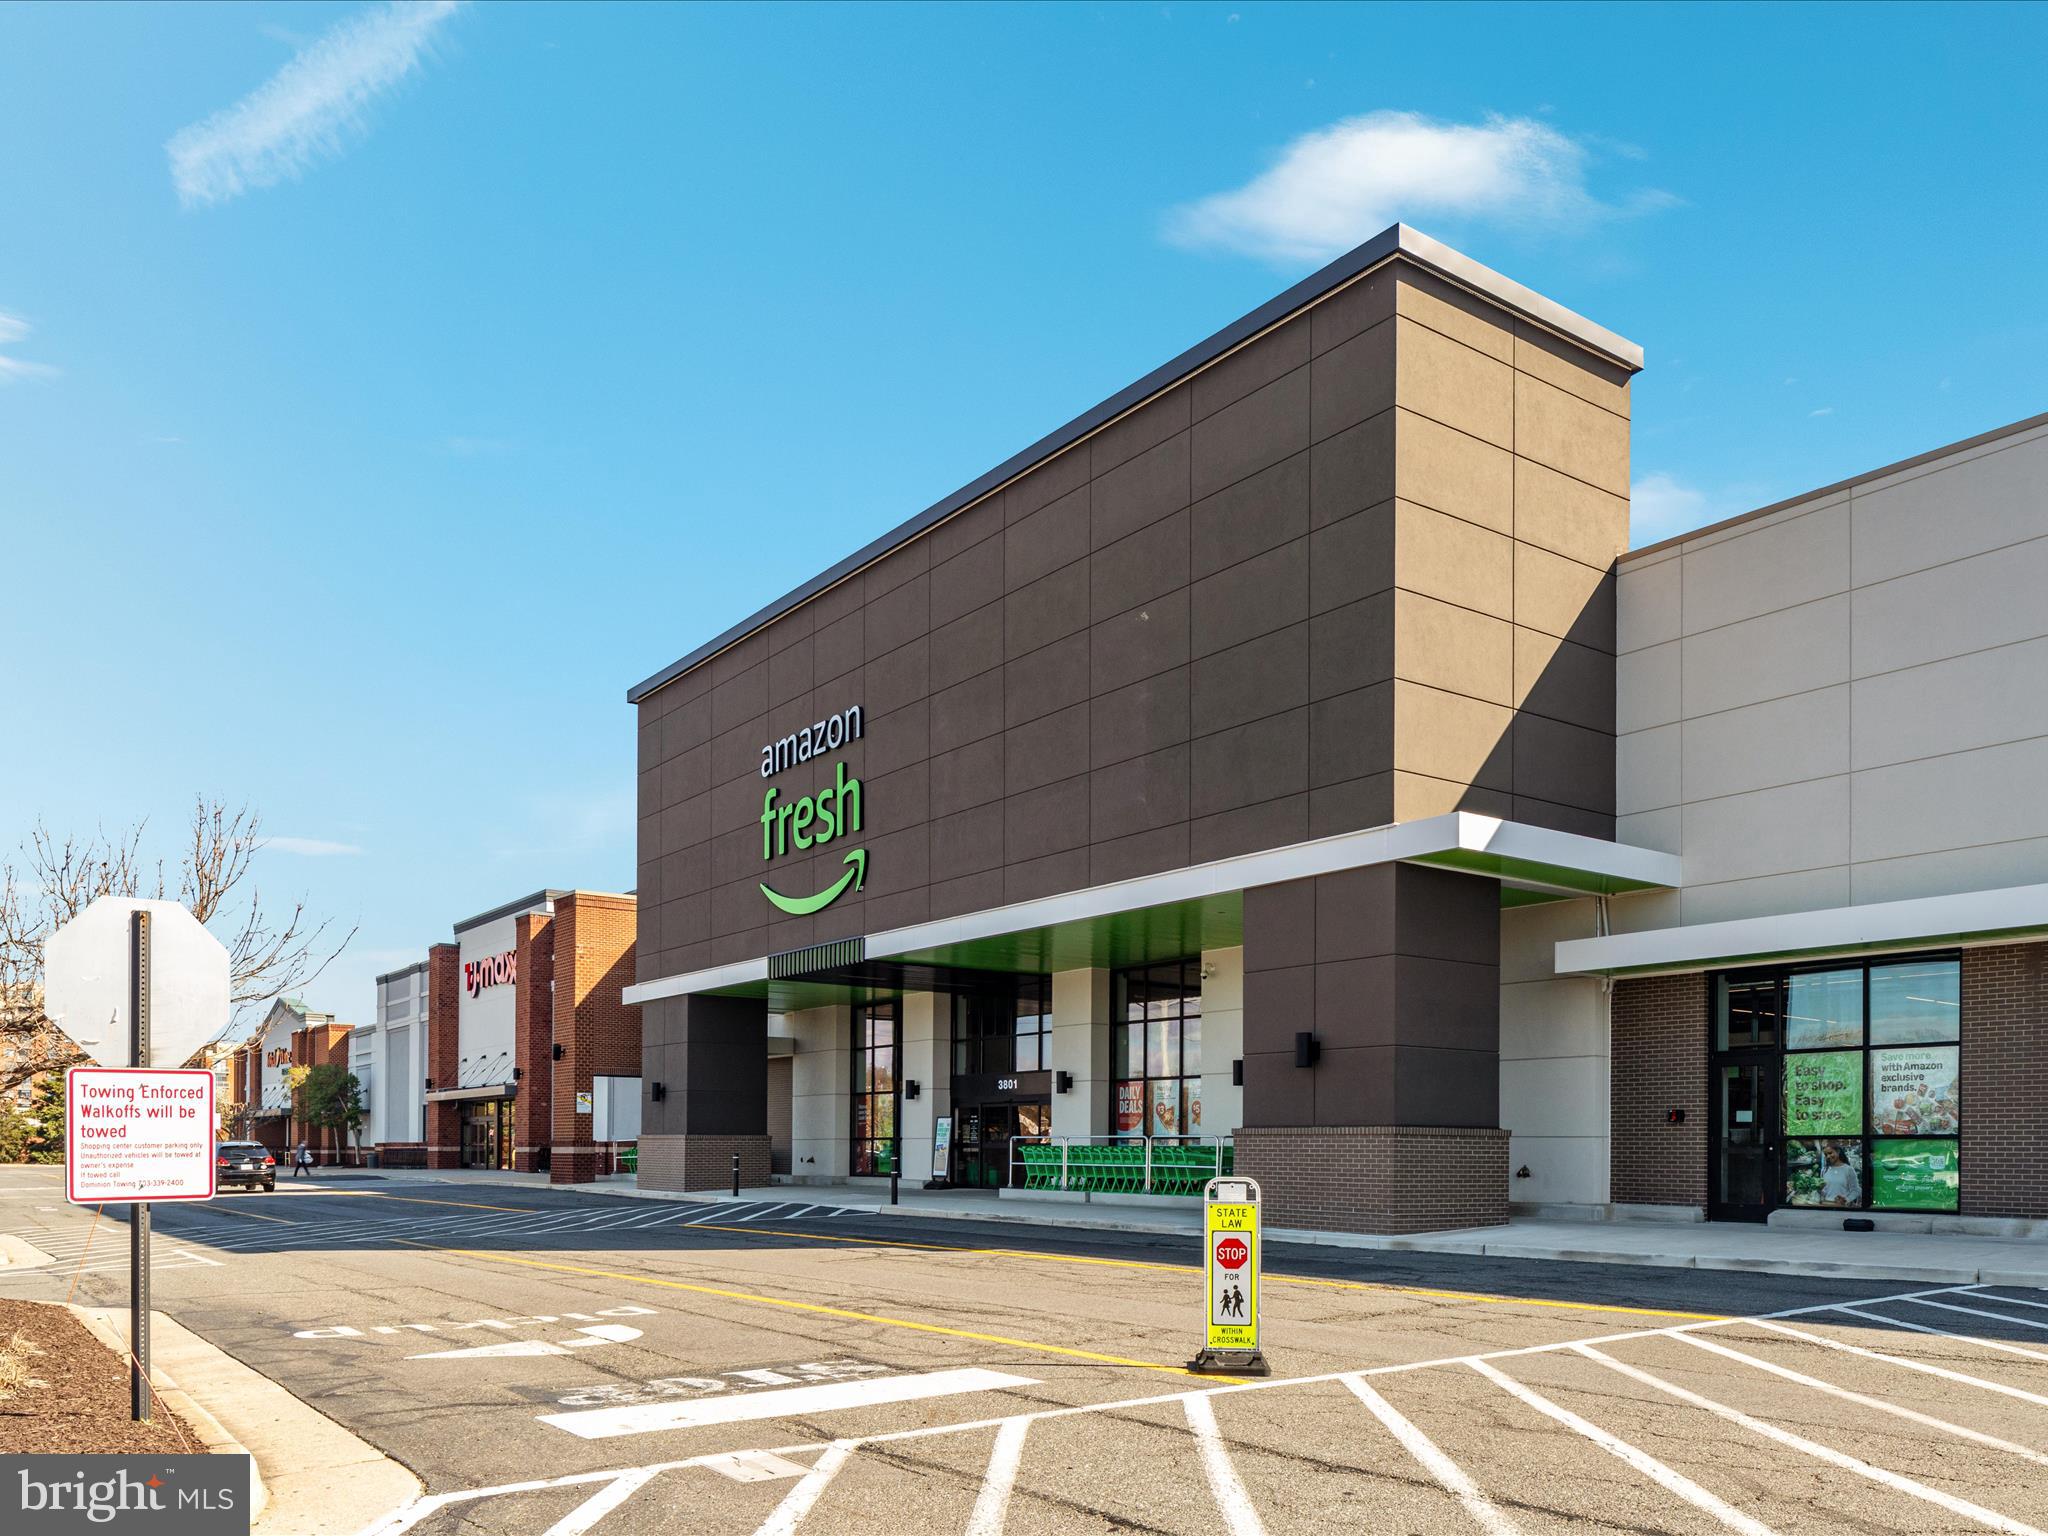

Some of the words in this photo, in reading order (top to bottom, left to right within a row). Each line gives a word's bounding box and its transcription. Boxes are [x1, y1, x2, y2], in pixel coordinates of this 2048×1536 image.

[760, 704, 862, 778] amazon
[760, 761, 862, 860] fresh
[1881, 1053, 1904, 1062] Save
[1795, 1064, 1826, 1078] Easy
[1881, 1062, 1902, 1072] with
[1903, 1061, 1943, 1071] Amazon
[1881, 1072, 1925, 1082] exclusive
[998, 1079, 1018, 1090] 3801
[1795, 1080, 1809, 1091] to
[1811, 1080, 1847, 1093] shop.
[1881, 1082, 1917, 1093] brands.
[80, 1084, 135, 1102] Towing
[141, 1085, 204, 1099] Enforced
[1119, 1086, 1141, 1100] DAILY
[1795, 1094, 1825, 1108] Easy
[80, 1104, 141, 1119] Walkoffs
[147, 1104, 173, 1119] will
[179, 1105, 196, 1119] be
[1119, 1100, 1143, 1114] DEALS
[1795, 1109, 1809, 1121] to
[1811, 1110, 1846, 1121] save.
[80, 1124, 127, 1138] towed
[80, 1142, 111, 1150] Shopping
[164, 1142, 188, 1150] parking
[190, 1142, 203, 1150] only
[113, 1181, 136, 1189] Towing
[1216, 1208, 1248, 1218] STATE
[1221, 1219, 1242, 1228] LAW
[1217, 1247, 1247, 1260] STOP
[1224, 1273, 1240, 1281] FOR
[1221, 1327, 1243, 1335] WITHIN
[1212, 1336, 1251, 1344] CROSSWALK
